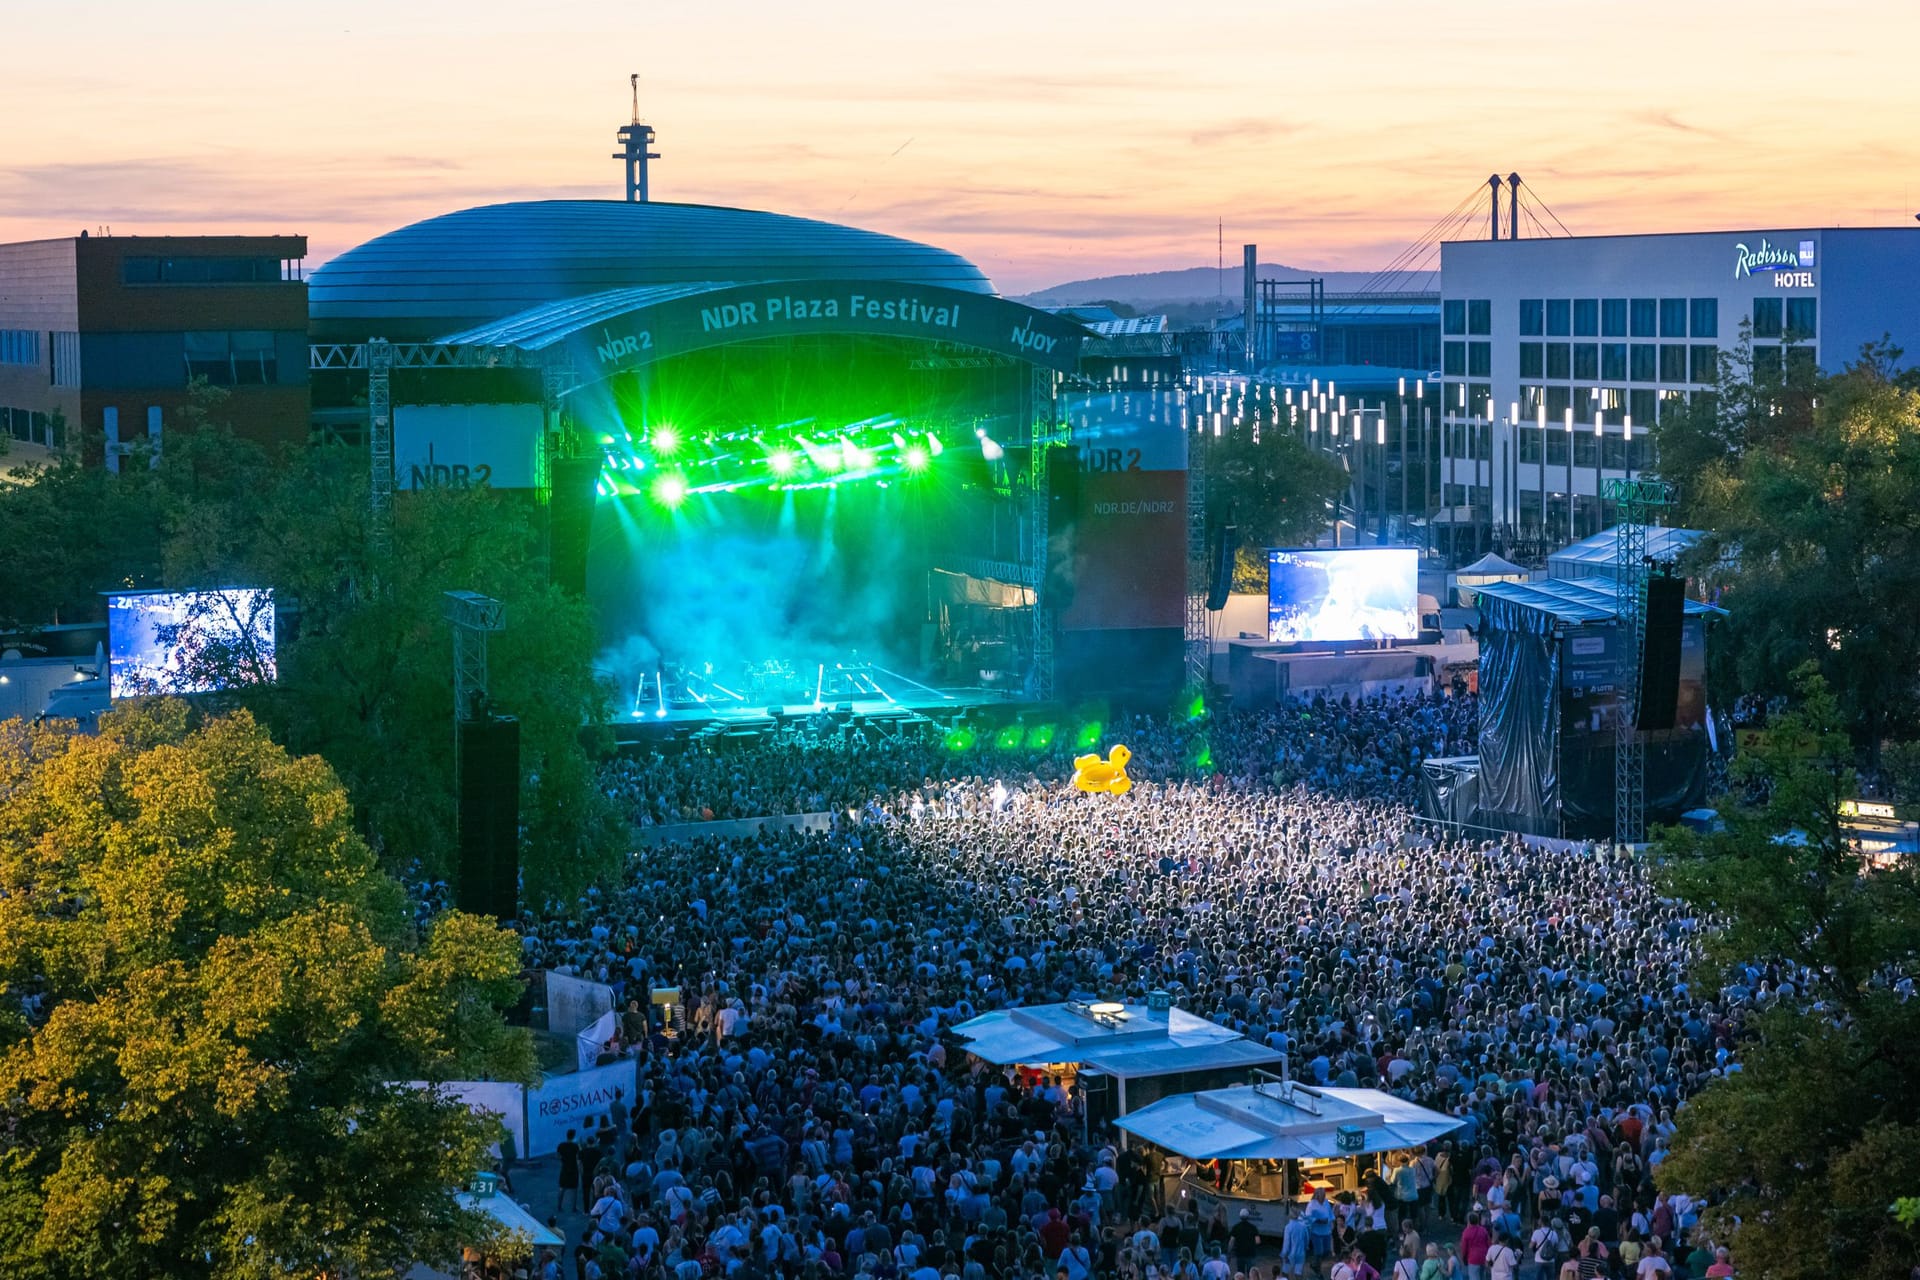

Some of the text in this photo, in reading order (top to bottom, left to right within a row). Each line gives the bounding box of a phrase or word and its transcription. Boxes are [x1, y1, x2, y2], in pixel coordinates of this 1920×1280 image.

[1735, 239, 1798, 280] Radisson
[1775, 272, 1815, 287] HOTEL
[701, 295, 960, 332] NDR Plaza Festival
[1093, 500, 1175, 515] NDR.DE/NDR2
[539, 1083, 625, 1117] ROSSMANN
[1348, 1135, 1363, 1147] 29
[477, 1181, 494, 1193] 31
